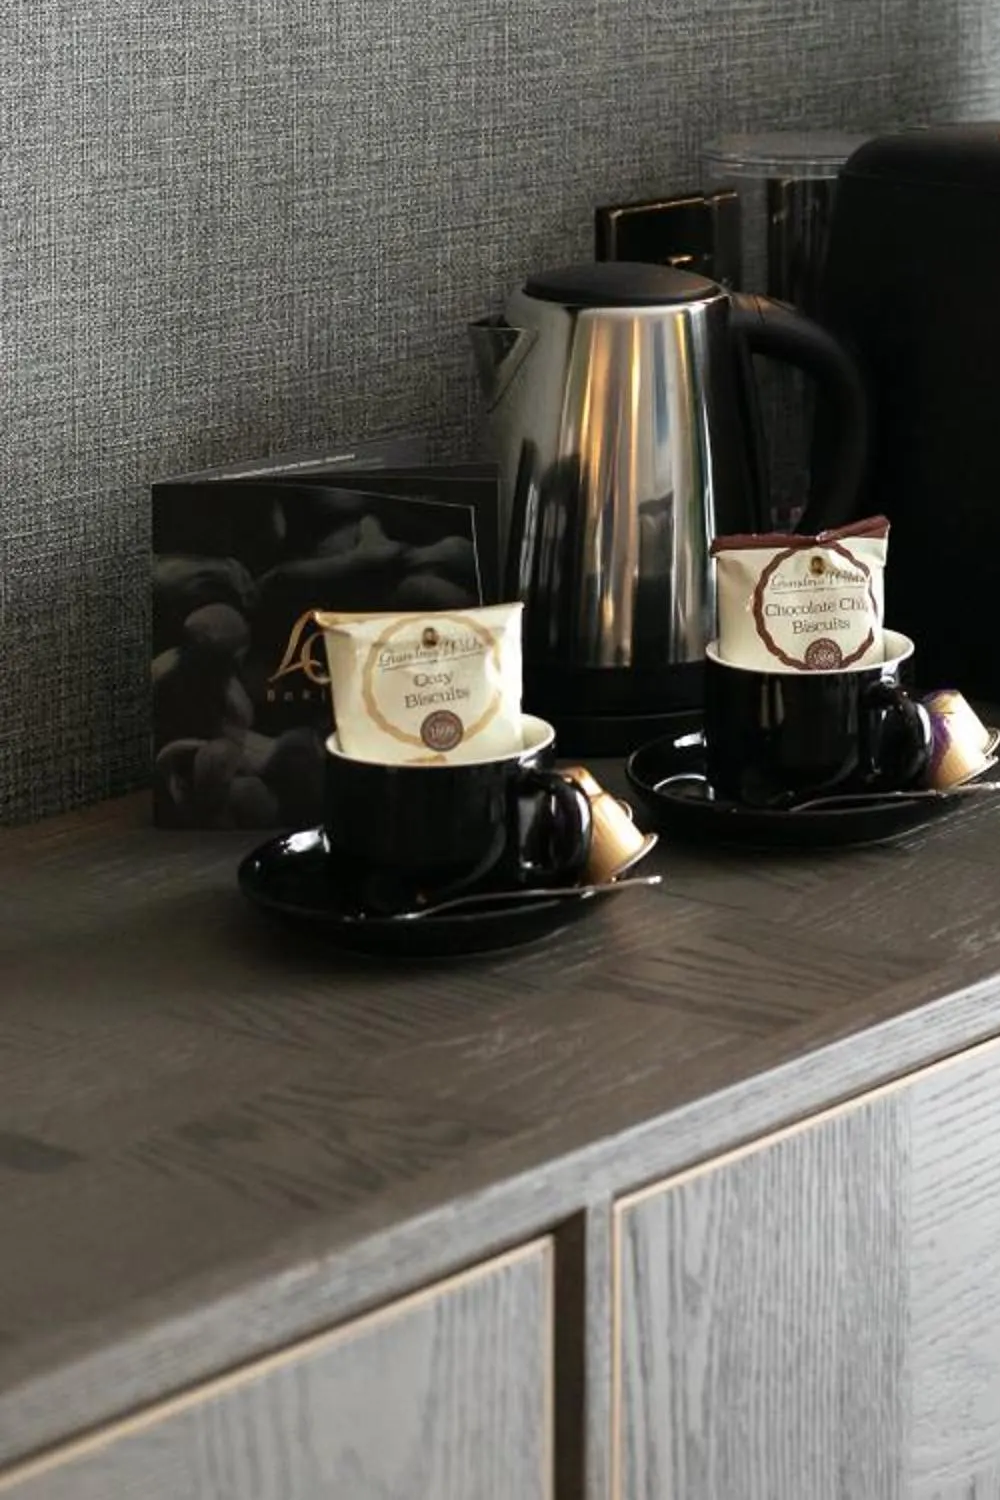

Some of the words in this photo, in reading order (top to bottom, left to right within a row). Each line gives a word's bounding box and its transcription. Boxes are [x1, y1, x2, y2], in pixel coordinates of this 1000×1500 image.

[764, 601, 836, 617] Chocolate
[792, 617, 851, 635] Biscuits
[404, 686, 470, 709] Biscuits
